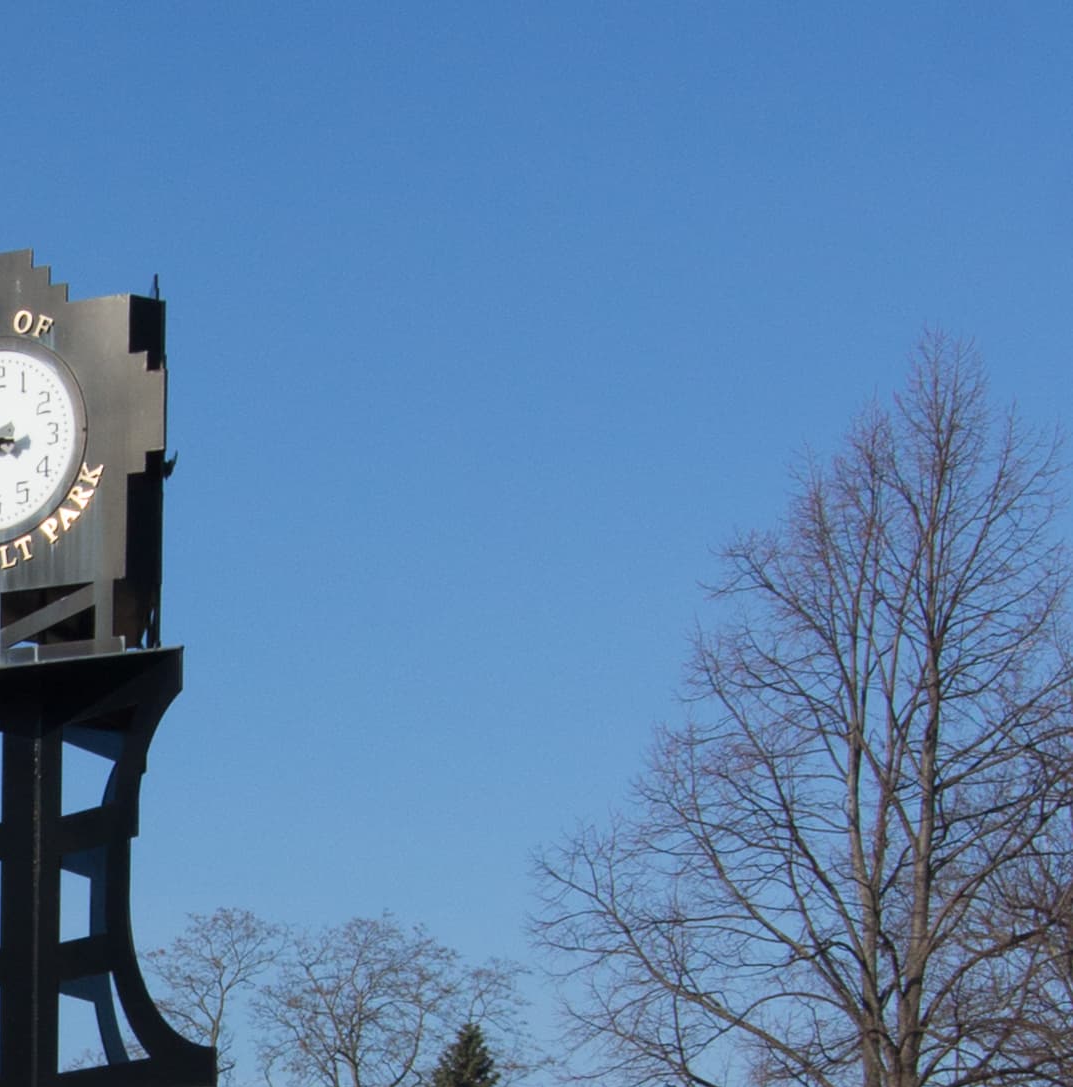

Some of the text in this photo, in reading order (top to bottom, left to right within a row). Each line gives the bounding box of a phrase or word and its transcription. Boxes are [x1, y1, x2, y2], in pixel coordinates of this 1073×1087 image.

[13, 310, 53, 337] OF
[21, 371, 26, 393] 1
[37, 392, 50, 414] 2
[47, 422, 58, 445] 3
[37, 456, 49, 477] 4
[16, 481, 29, 504] 5
[40, 462, 104, 544] PARK
